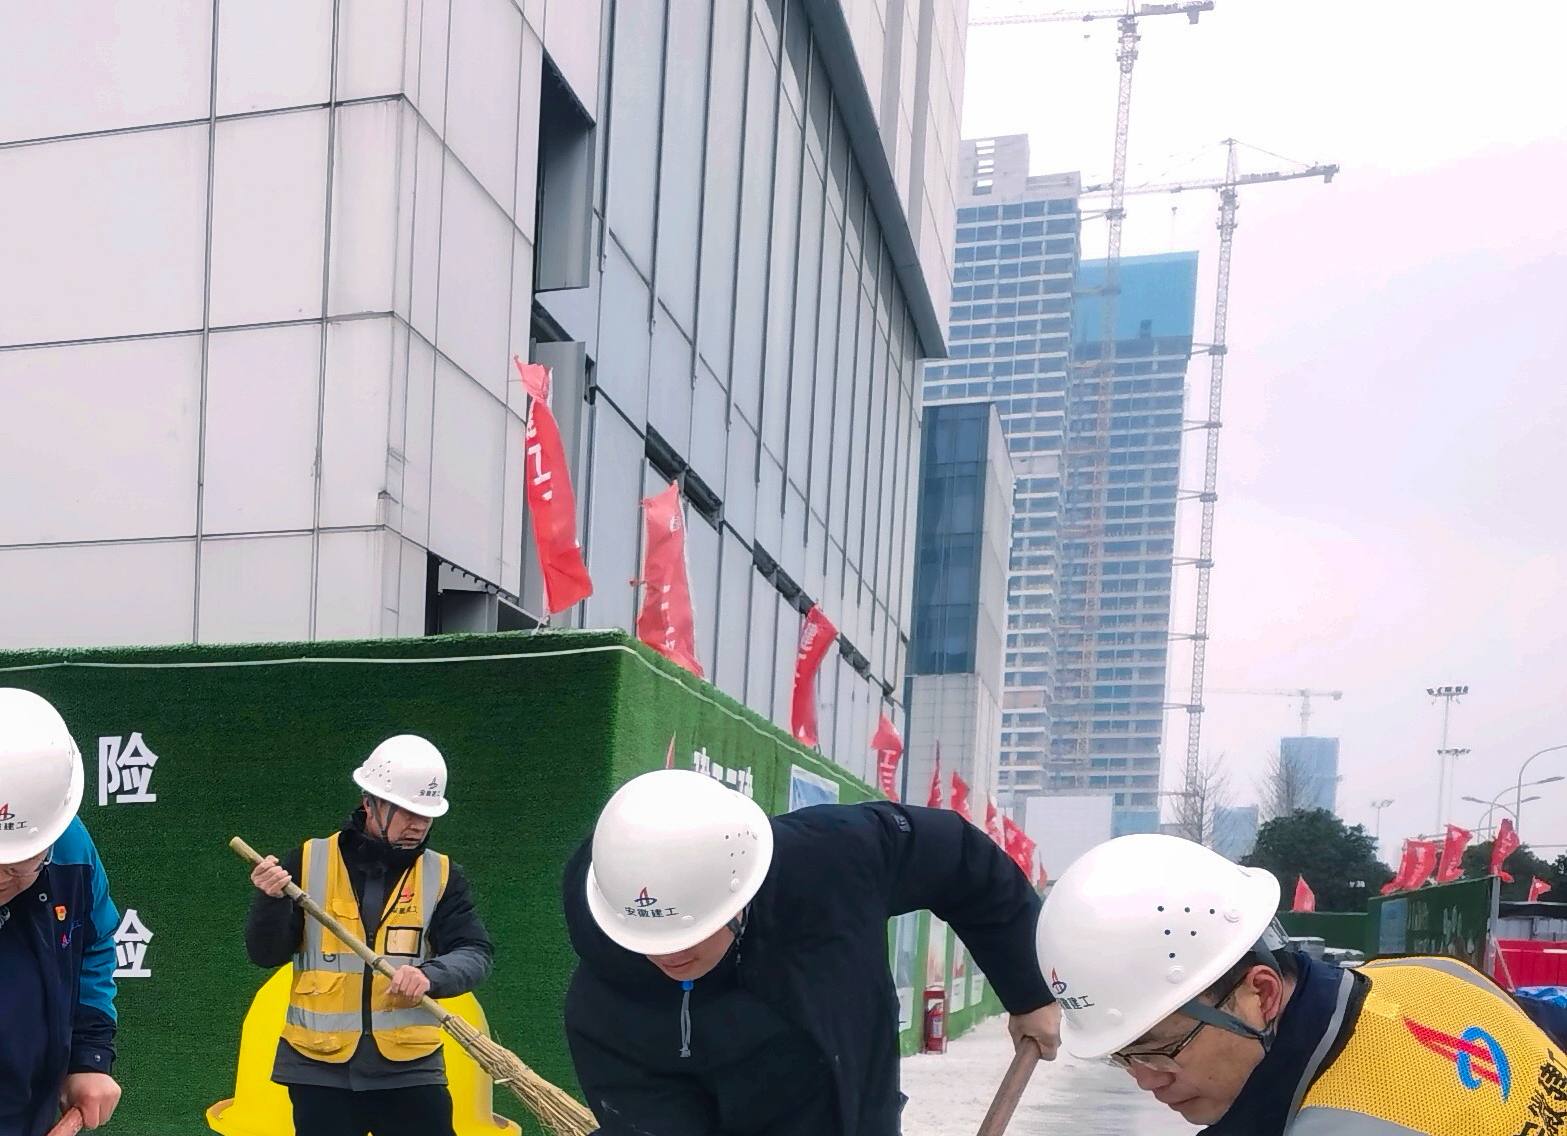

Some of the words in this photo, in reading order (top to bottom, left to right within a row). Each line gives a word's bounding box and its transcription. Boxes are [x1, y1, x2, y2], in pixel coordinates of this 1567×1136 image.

[97, 732, 159, 806] 险
[624, 906, 680, 918] 安徽建工
